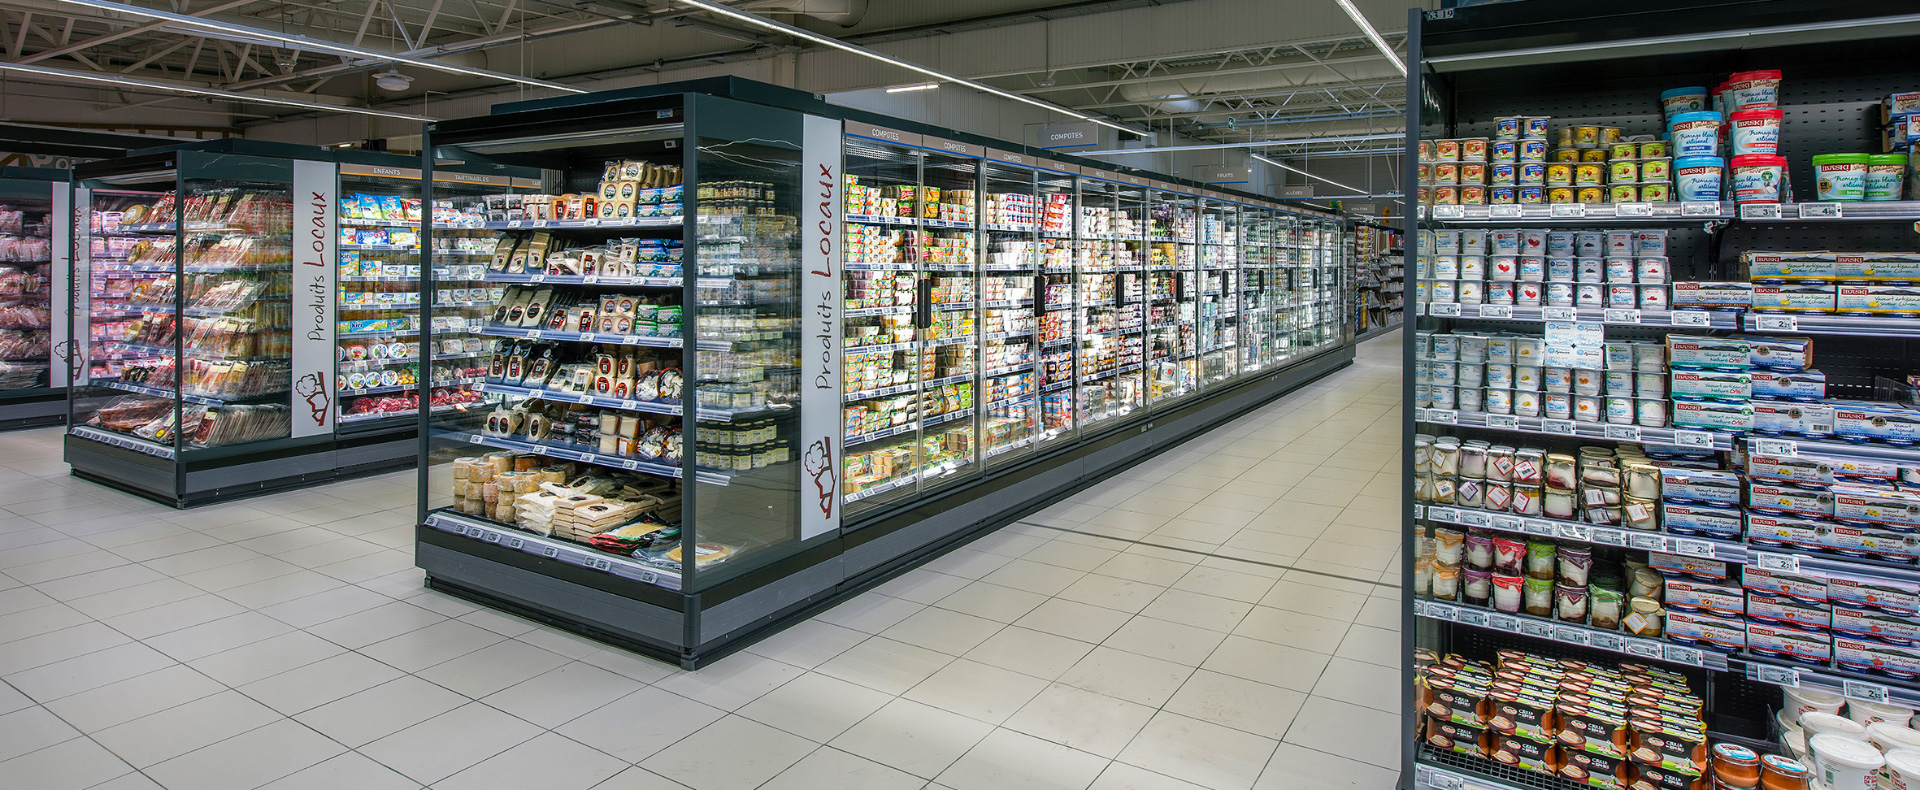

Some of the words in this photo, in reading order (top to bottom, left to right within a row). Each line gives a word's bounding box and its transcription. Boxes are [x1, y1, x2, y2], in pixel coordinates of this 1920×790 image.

[872, 128, 899, 140] COMPOTES
[1050, 131, 1083, 141] COMPOTES
[1680, 132, 1701, 140] Fromage
[944, 142, 966, 152] COMPOTES
[373, 167, 401, 176] ENFANTS
[454, 174, 490, 183] TARTINABLES
[811, 162, 834, 278] Locaux
[303, 191, 327, 267] Locaux
[307, 275, 326, 341] Produits
[815, 290, 833, 390] Produits
